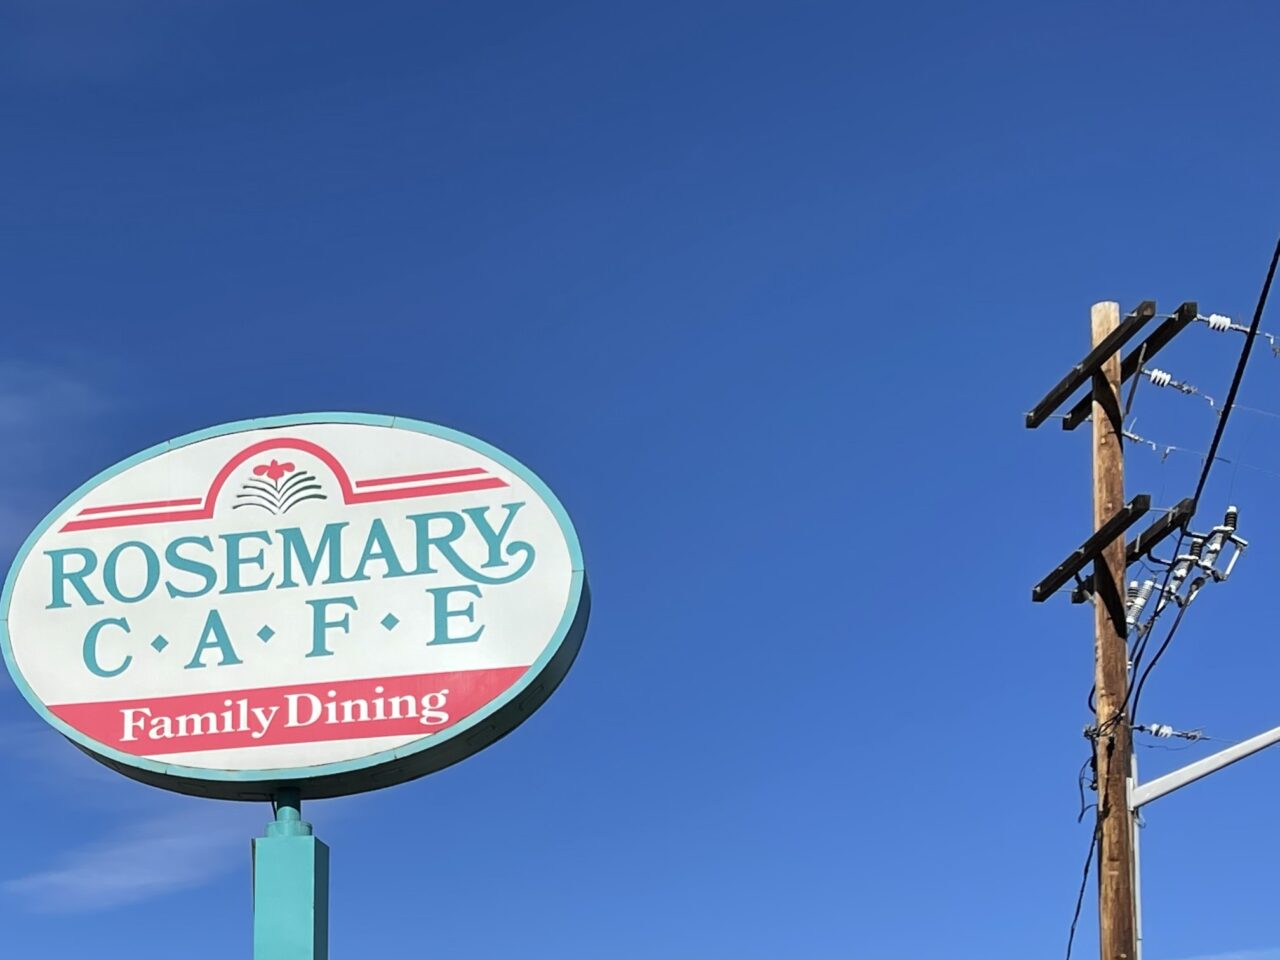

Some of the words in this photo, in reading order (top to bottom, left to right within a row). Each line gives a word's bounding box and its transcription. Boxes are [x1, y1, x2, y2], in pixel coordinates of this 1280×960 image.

[44, 501, 535, 609] ROSEMARY
[120, 699, 280, 741] Family
[283, 686, 450, 728] Dining
